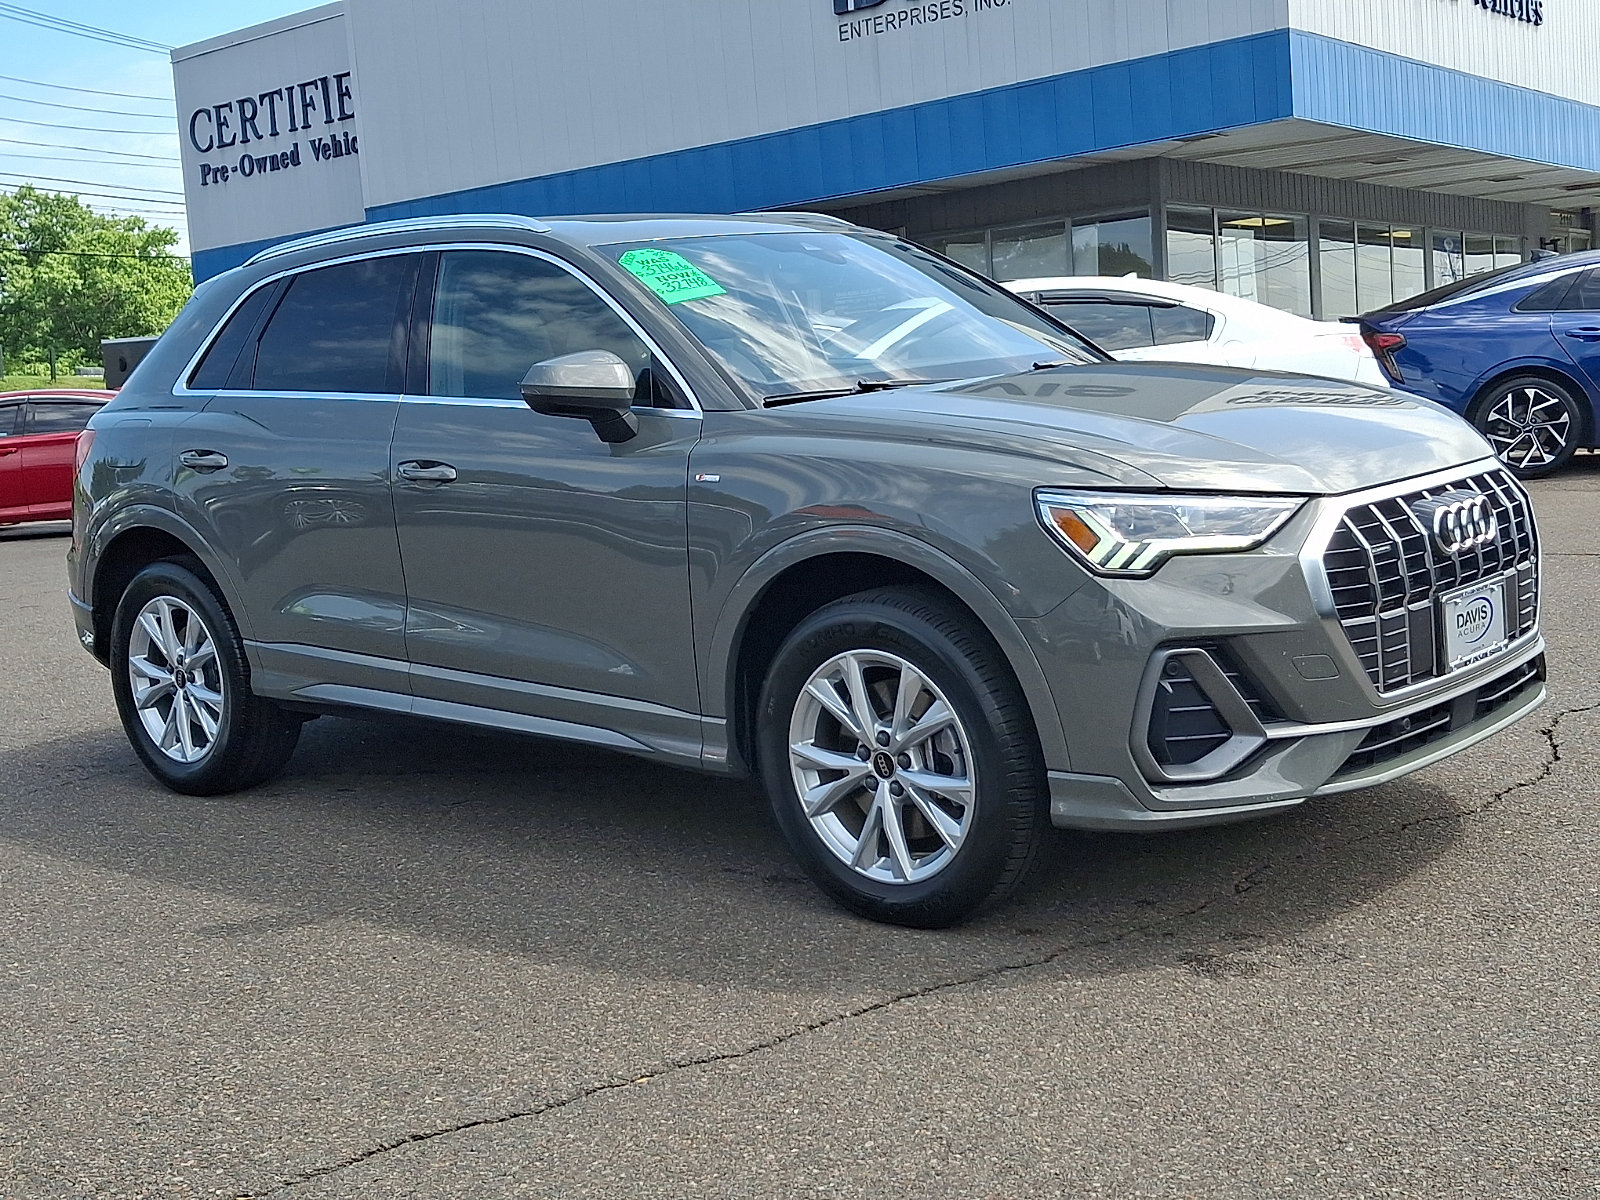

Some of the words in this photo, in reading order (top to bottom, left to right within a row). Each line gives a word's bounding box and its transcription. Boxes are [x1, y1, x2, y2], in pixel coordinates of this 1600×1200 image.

[838, 0, 968, 42] ENTERPRISES,
[189, 71, 355, 153] CERTIFIE
[199, 143, 301, 186] Pre-Owned
[635, 256, 670, 266] WAS
[655, 271, 691, 283] NOW
[1456, 604, 1488, 630] DAVIS
[1457, 621, 1487, 639] ACURA
